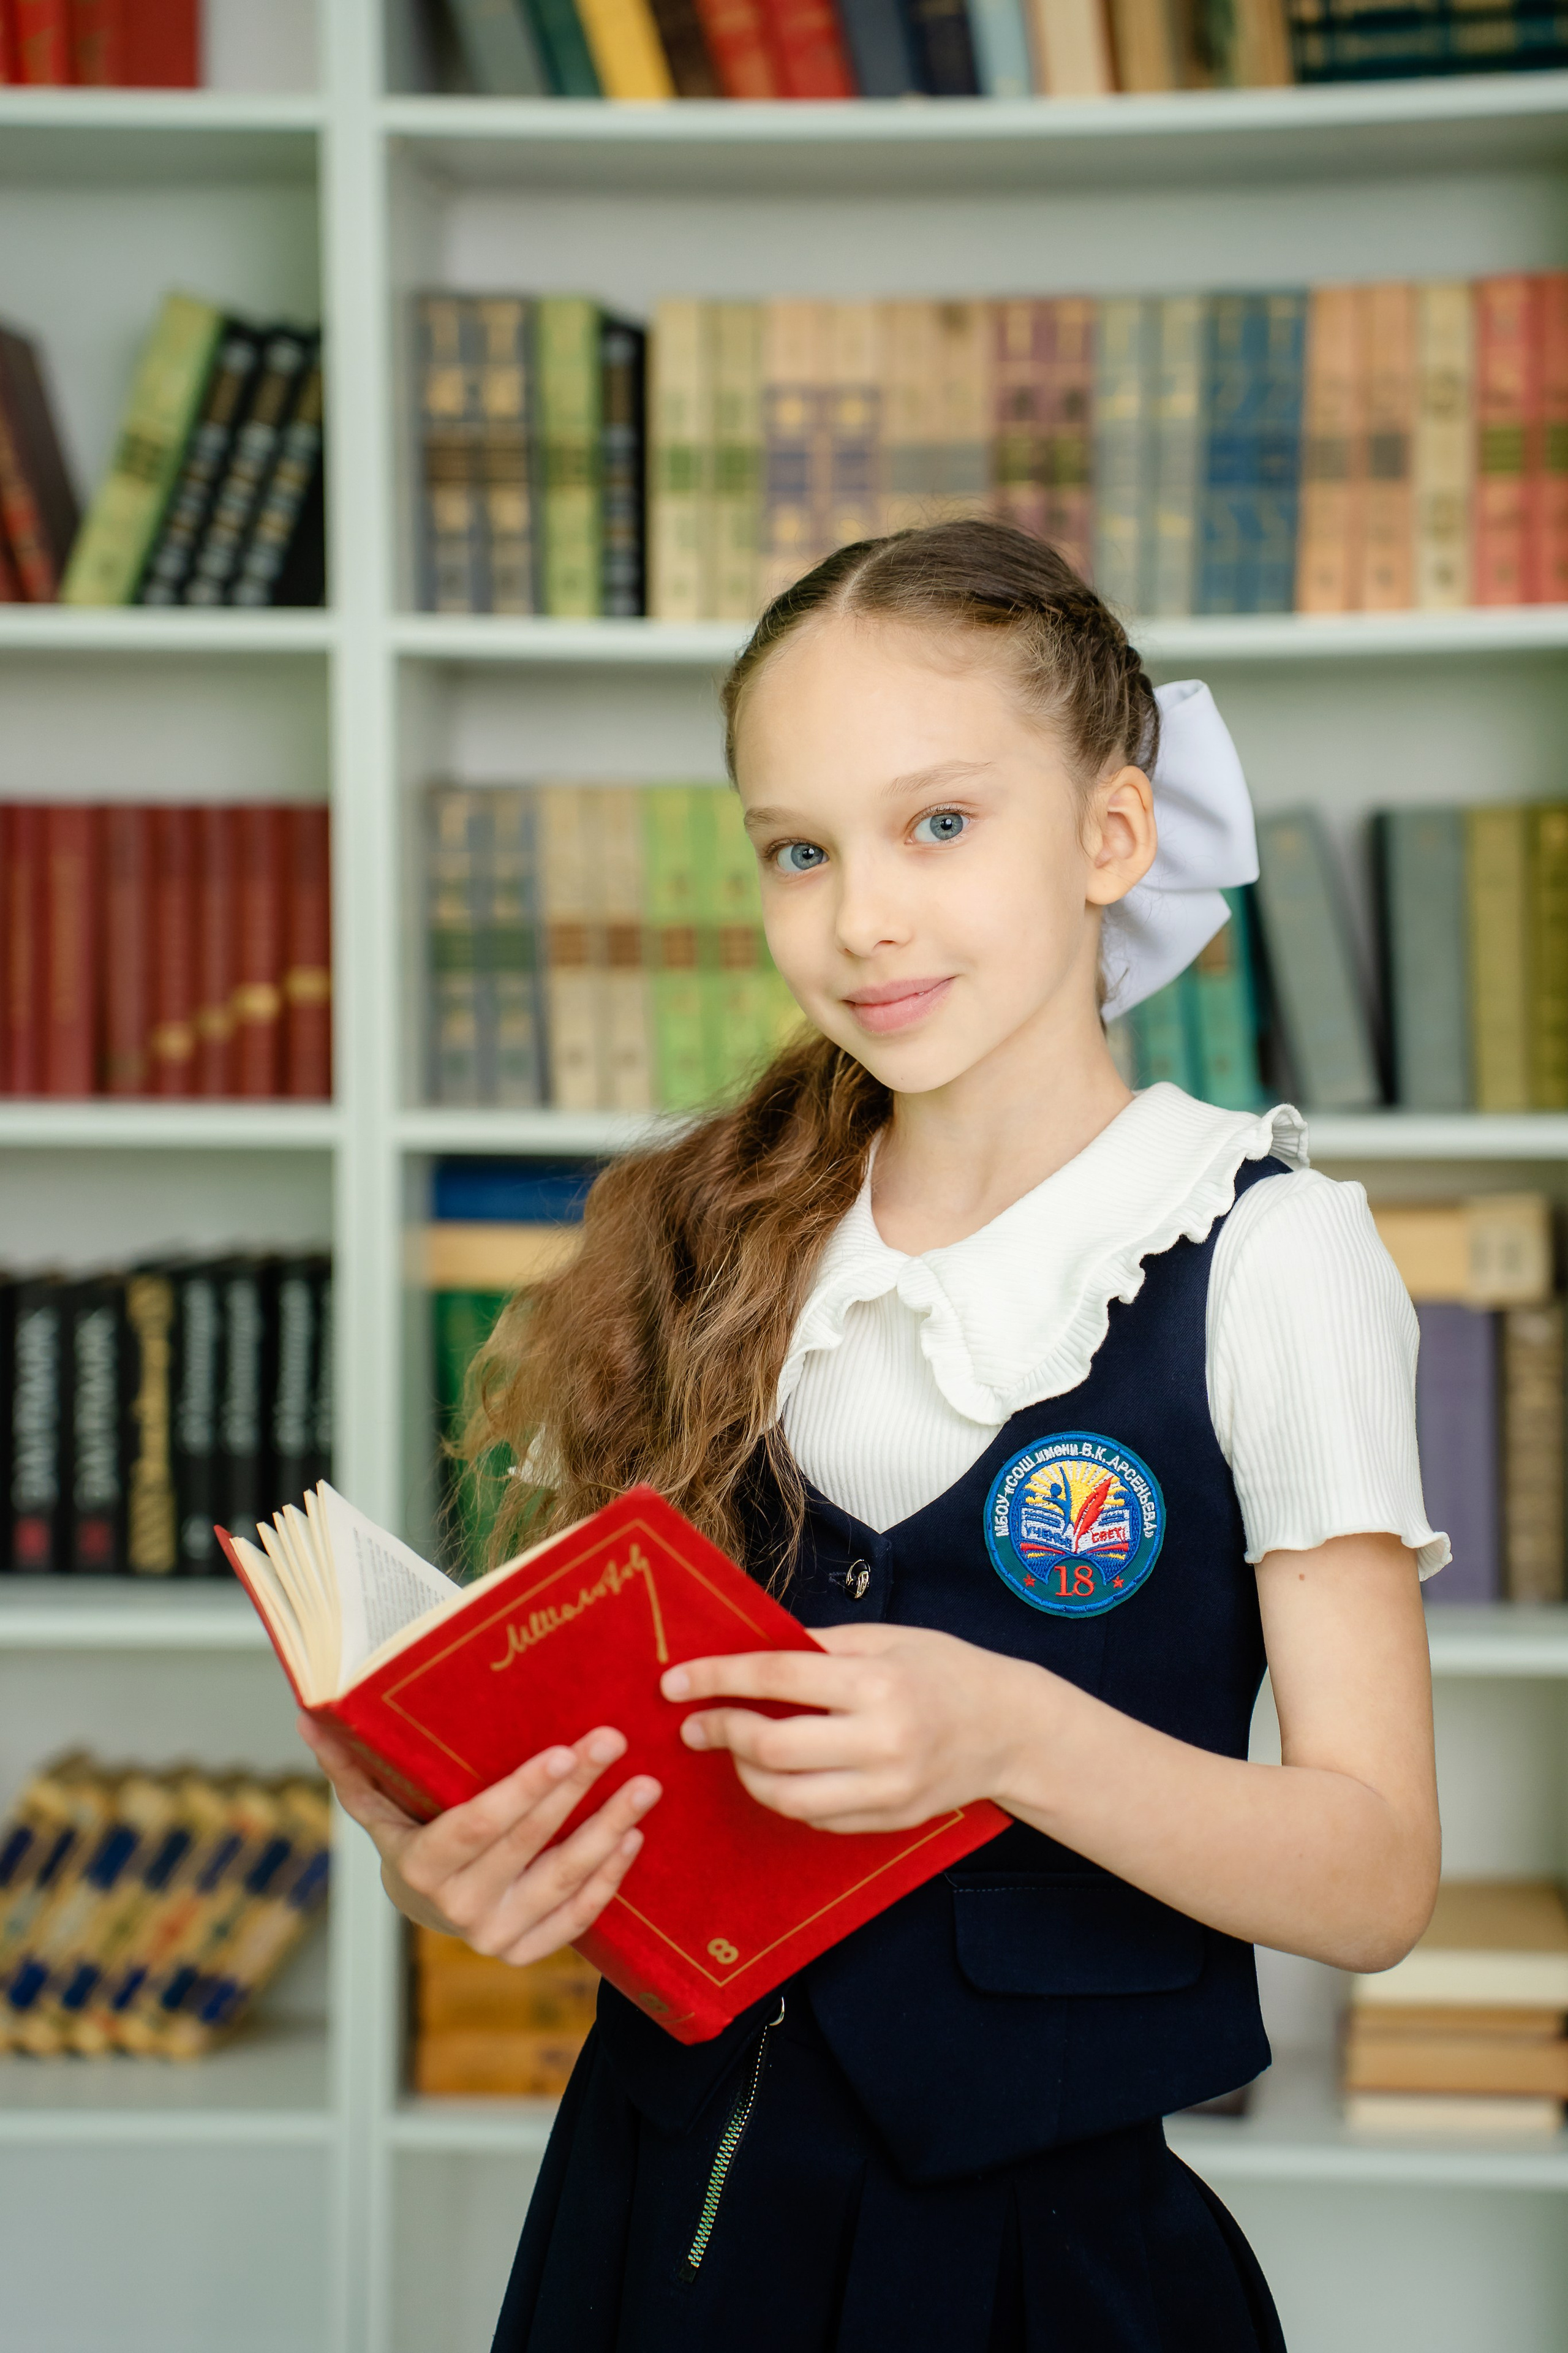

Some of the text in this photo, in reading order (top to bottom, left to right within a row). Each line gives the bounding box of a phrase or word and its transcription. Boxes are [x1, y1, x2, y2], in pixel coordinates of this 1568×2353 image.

[995, 1494, 1009, 1536] МБОУ
[1054, 1566, 1095, 1596] 18
[707, 1938, 739, 1965] 8
